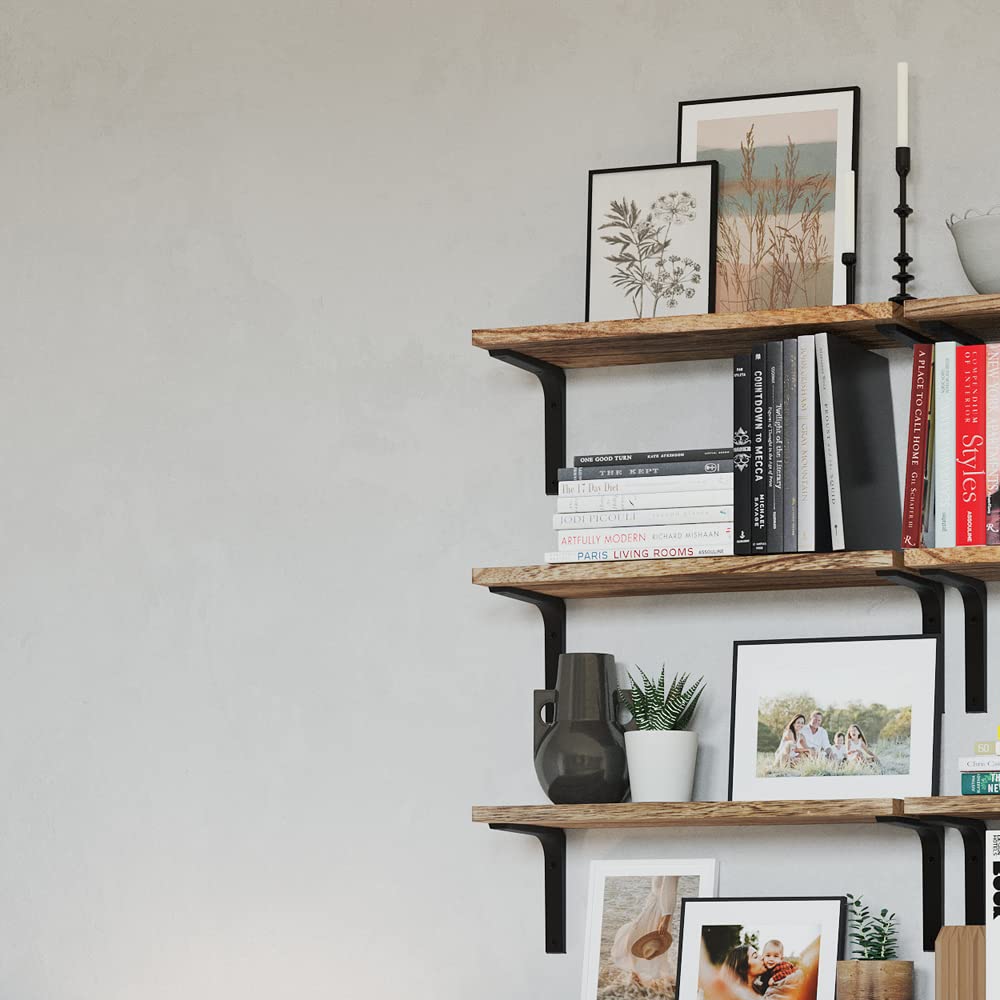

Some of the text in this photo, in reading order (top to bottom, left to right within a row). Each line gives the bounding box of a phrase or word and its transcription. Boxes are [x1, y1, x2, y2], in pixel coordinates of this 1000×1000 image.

[915, 359, 926, 390] PLACE
[914, 391, 924, 407] TO
[754, 370, 763, 482] COUNTDOWN TO MECCA
[913, 408, 922, 434] CALL
[911, 435, 921, 466] HOME
[580, 454, 632, 464] ONE GOOD TURN
[629, 467, 659, 475] KEPT
[956, 434, 986, 503] Styles
[561, 533, 646, 545] ARTFULLY MODERN
[652, 530, 720, 541] RICHARD MISHAAN
[577, 547, 694, 560] PARIS LIVING ROOMS
